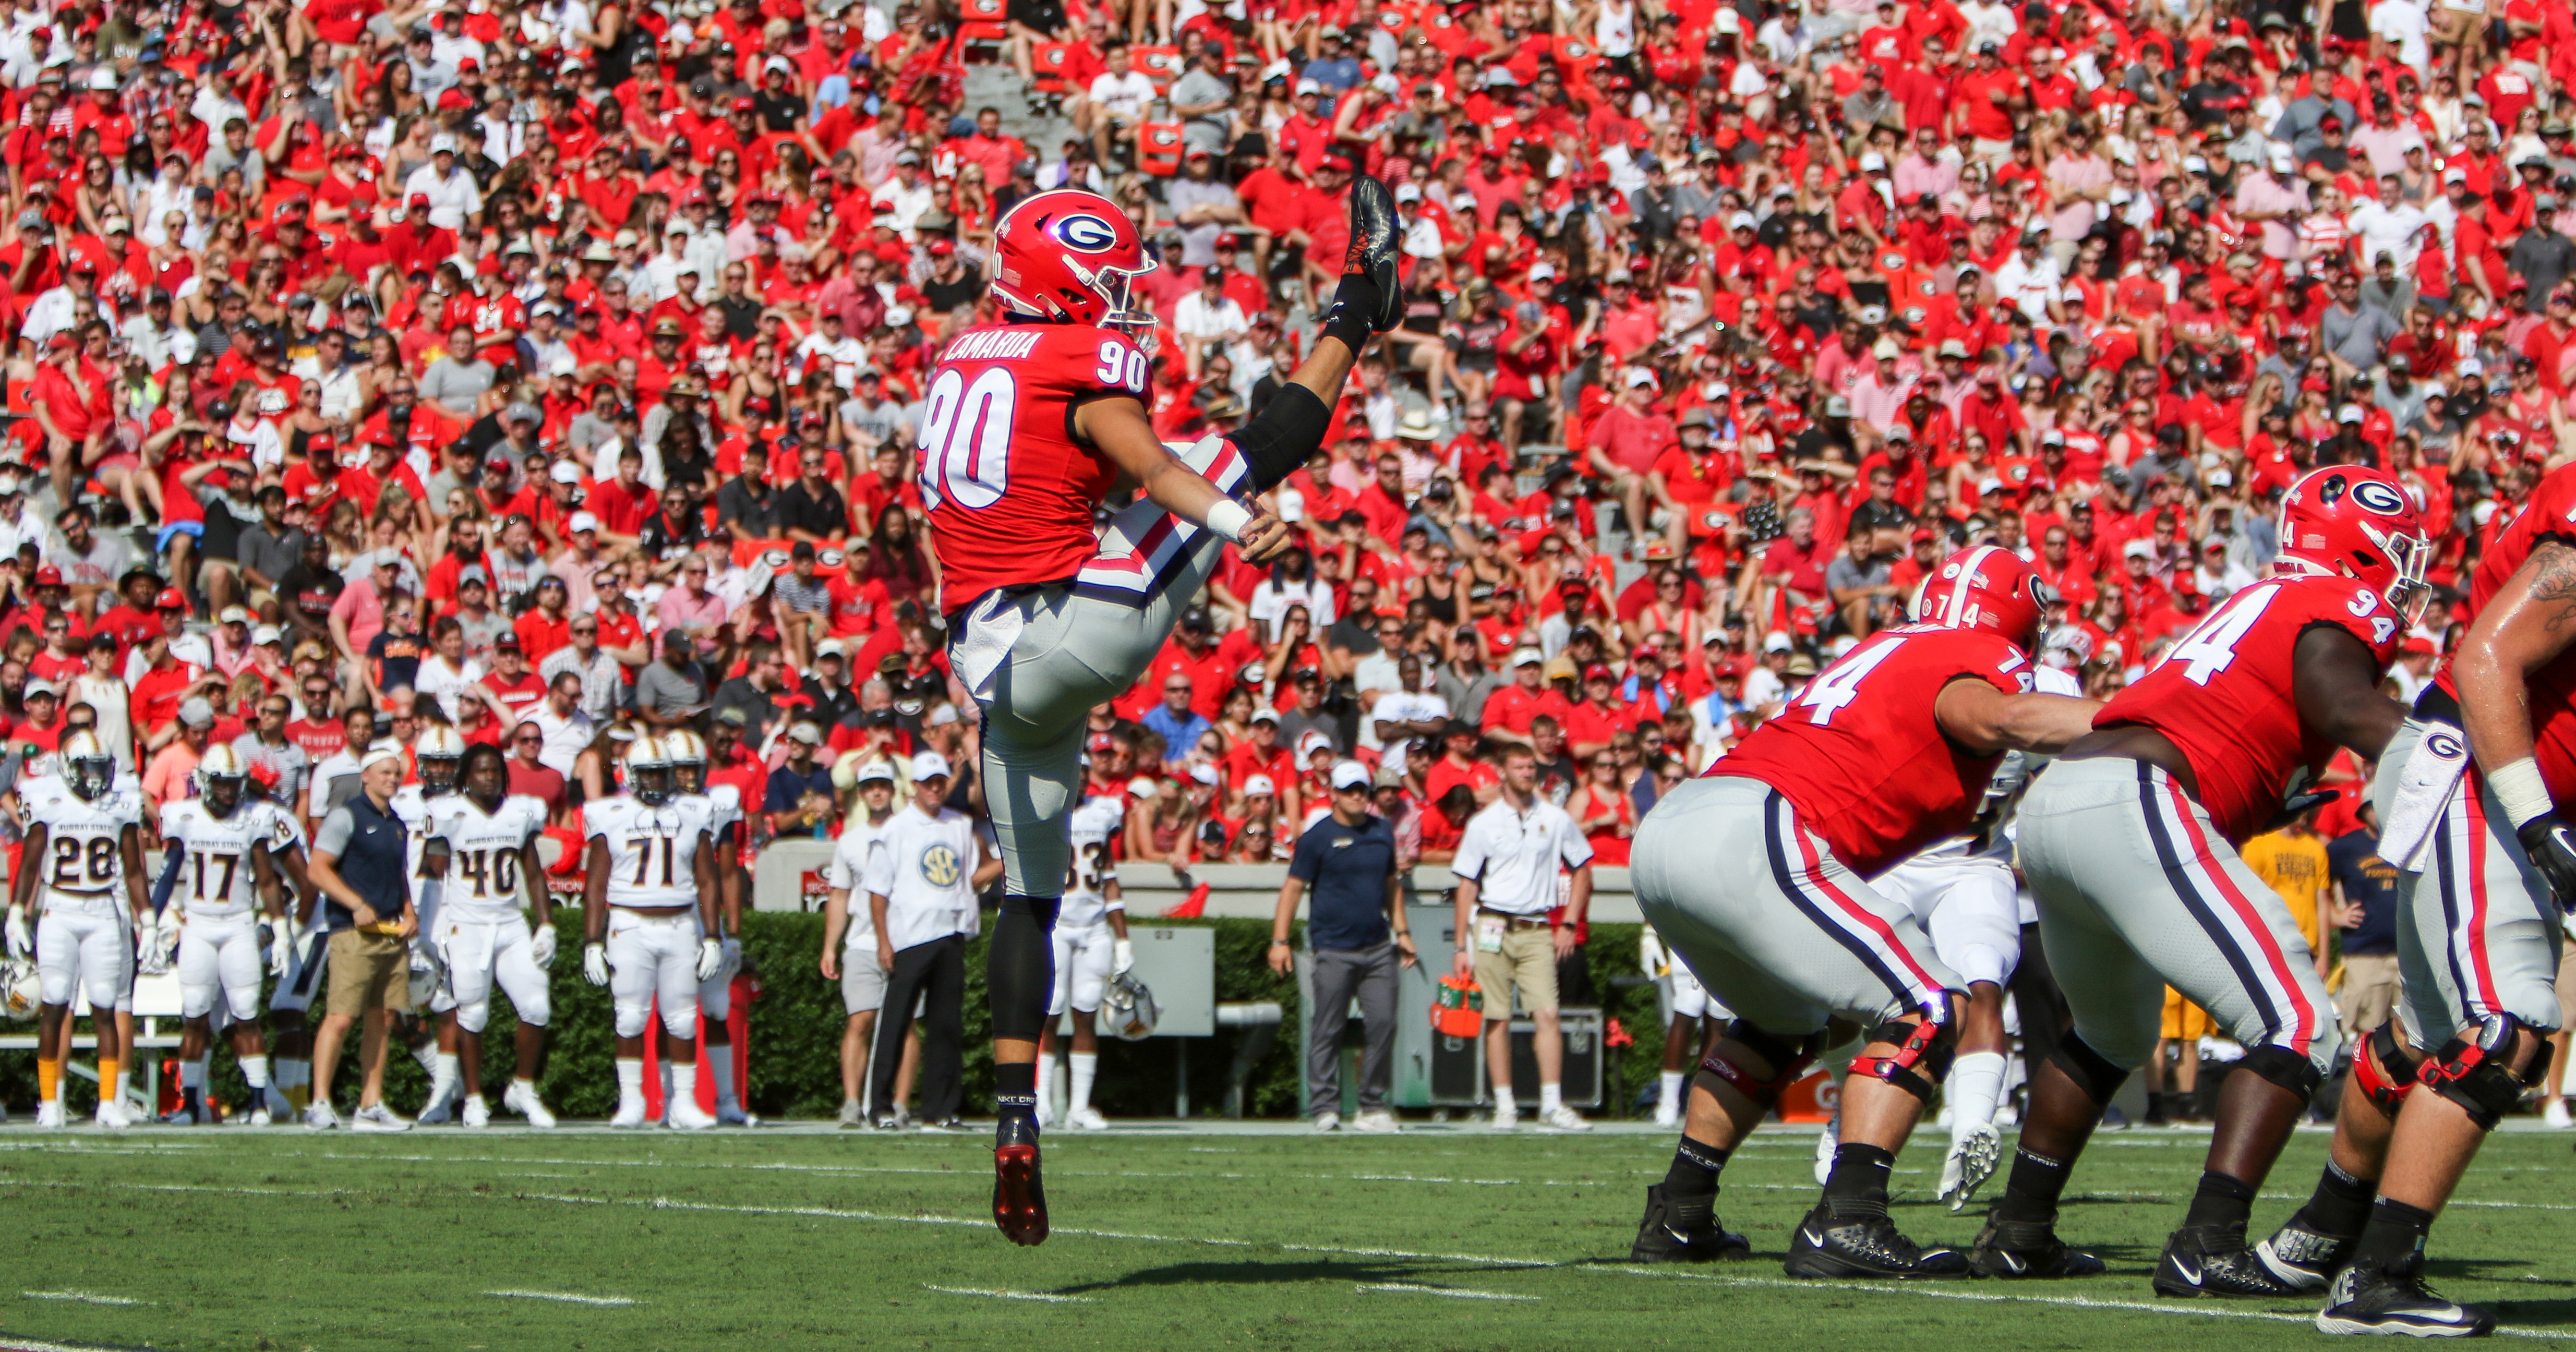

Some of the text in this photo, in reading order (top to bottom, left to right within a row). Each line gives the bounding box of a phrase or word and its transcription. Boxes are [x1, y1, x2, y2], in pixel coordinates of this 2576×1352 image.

[945, 330, 1043, 361] CAMARDA
[1096, 341, 1147, 393] 90
[917, 366, 1016, 511] 90
[2146, 584, 2282, 686] 4
[2347, 589, 2396, 644] 94
[1997, 646, 2033, 693] 74
[58, 824, 88, 832] MURRAY
[190, 840, 219, 848] MURRAY
[465, 836, 496, 846] MURRAY
[54, 836, 116, 884] 28
[192, 852, 240, 903] 17
[457, 847, 520, 897] 40
[627, 837, 673, 887] 71
[923, 845, 958, 886] SEC
[2272, 1228, 2340, 1263] NIKE
